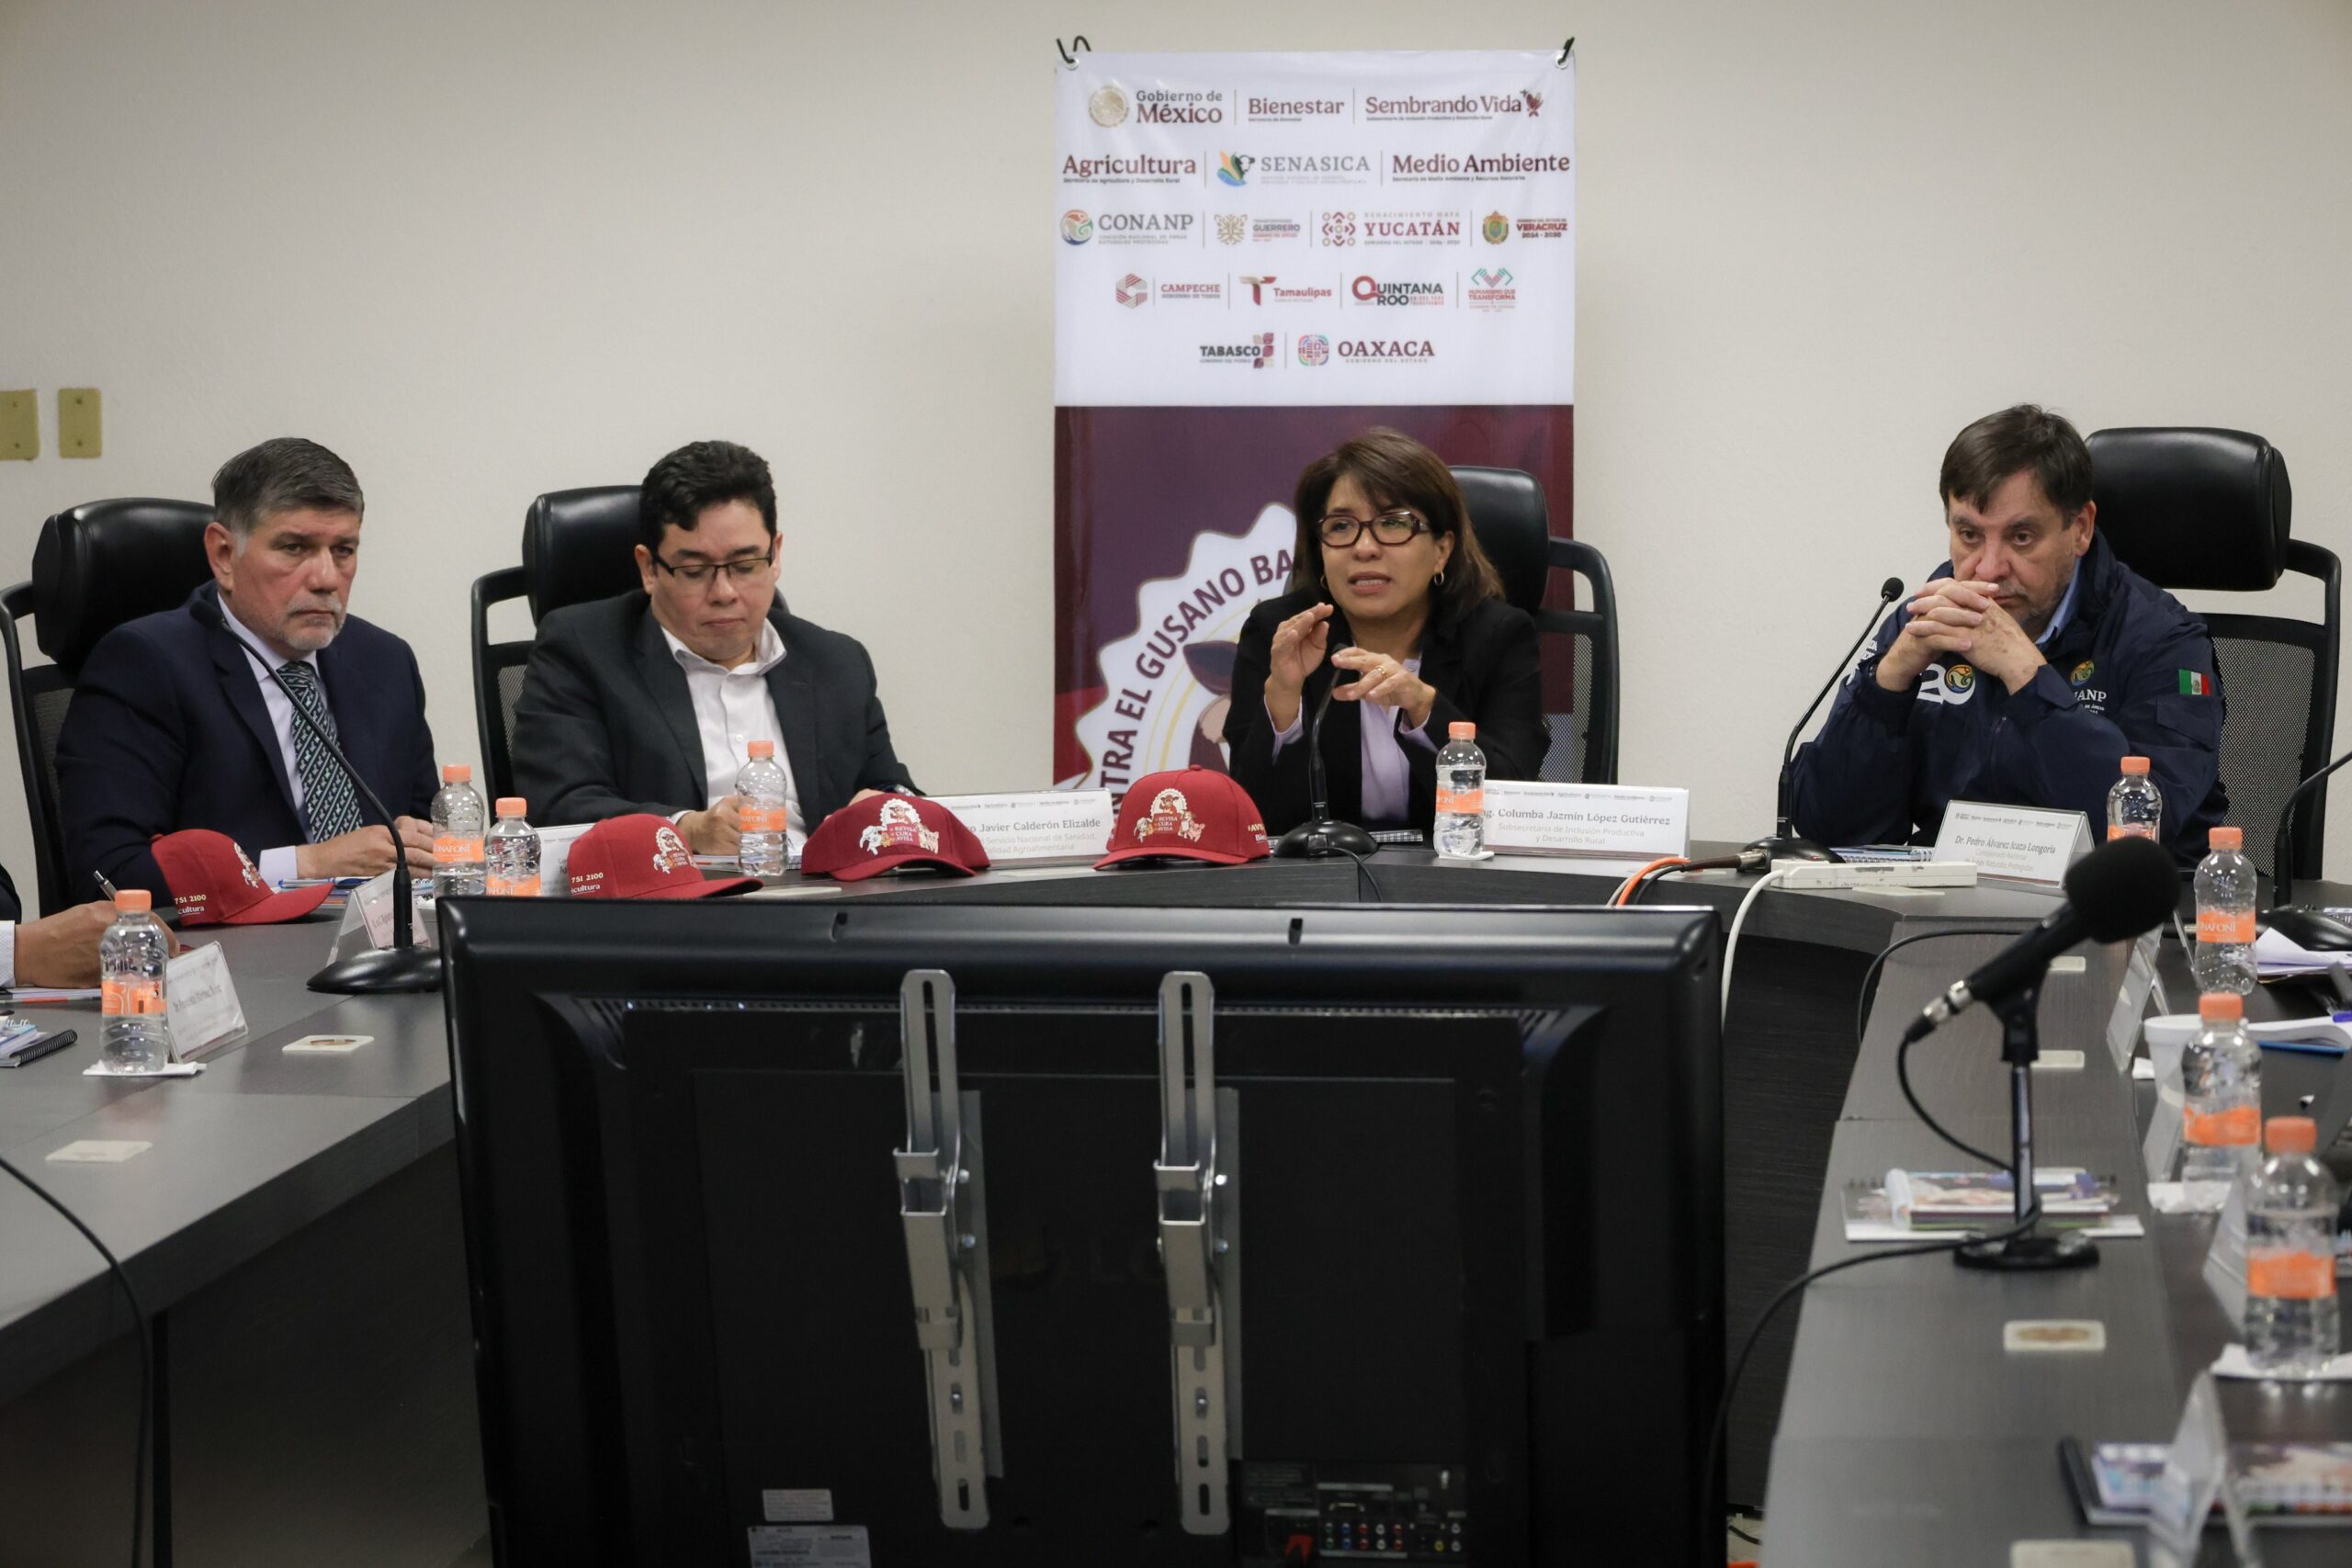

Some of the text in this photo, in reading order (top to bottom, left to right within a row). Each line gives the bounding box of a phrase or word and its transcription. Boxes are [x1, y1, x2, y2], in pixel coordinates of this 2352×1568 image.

[1136, 90, 1223, 102] Gobierno de
[1365, 94, 1522, 114] Sembrando Vida
[1136, 102, 1223, 123] México
[1248, 97, 1345, 115] Bienestar
[1063, 153, 1197, 177] Agricultura
[1261, 156, 1371, 172] SENASICA
[1393, 152, 1571, 174] Medio Ambiente
[1099, 213, 1193, 231] CONANP
[1364, 220, 1460, 236] YUCATÁN
[1161, 284, 1220, 293] CAMPECHE
[1273, 288, 1332, 298] Tamaulipas
[1351, 276, 1444, 301] QUINTANA
[1377, 295, 1409, 306] ROO
[1200, 345, 1261, 356] TABASCO
[1338, 341, 1435, 357] OAXACA
[1100, 549, 1295, 808] TRA EL GUSANO BA
[2075, 689, 2107, 702] ANP
[1498, 808, 1544, 819] Columba
[1546, 810, 1584, 820] Jazmín
[1587, 812, 1618, 824] López
[1621, 814, 1670, 825] Gutiérrez
[979, 823, 1011, 832] Javier
[1013, 820, 1060, 831] Calderón
[1062, 818, 1101, 829] Elizalde
[1955, 835, 1964, 844] Dr.
[1965, 837, 1984, 846] Pedro
[2028, 842, 2056, 854] Longoria
[586, 872, 604, 881] 2100
[571, 884, 601, 894] icultura
[189, 894, 207, 902] 2100
[178, 906, 205, 915] cultura
